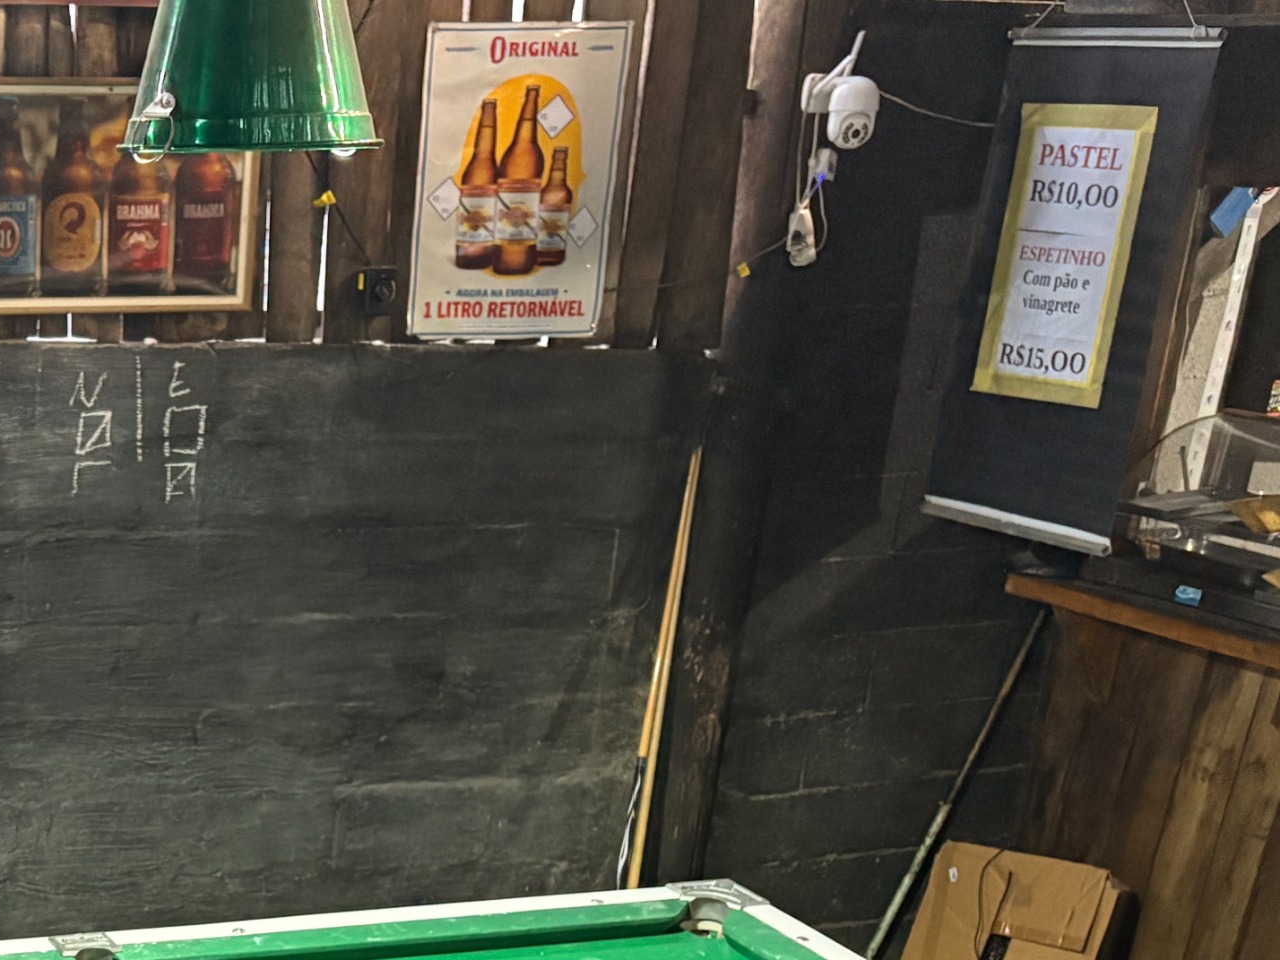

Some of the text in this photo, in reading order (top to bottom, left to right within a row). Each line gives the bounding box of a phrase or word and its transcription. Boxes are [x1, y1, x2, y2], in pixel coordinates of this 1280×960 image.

[1038, 143, 1123, 171] PASTEL
[1030, 179, 1119, 210] R$10,00
[116, 204, 160, 219] BRAHMA
[1019, 245, 1106, 267] ESPETINHO
[1023, 269, 1090, 292] Com pão e
[423, 296, 584, 318] 1 LITRO RETORNÁVEL
[1022, 294, 1080, 316] vinagrete
[999, 342, 1086, 375] R$15,00
